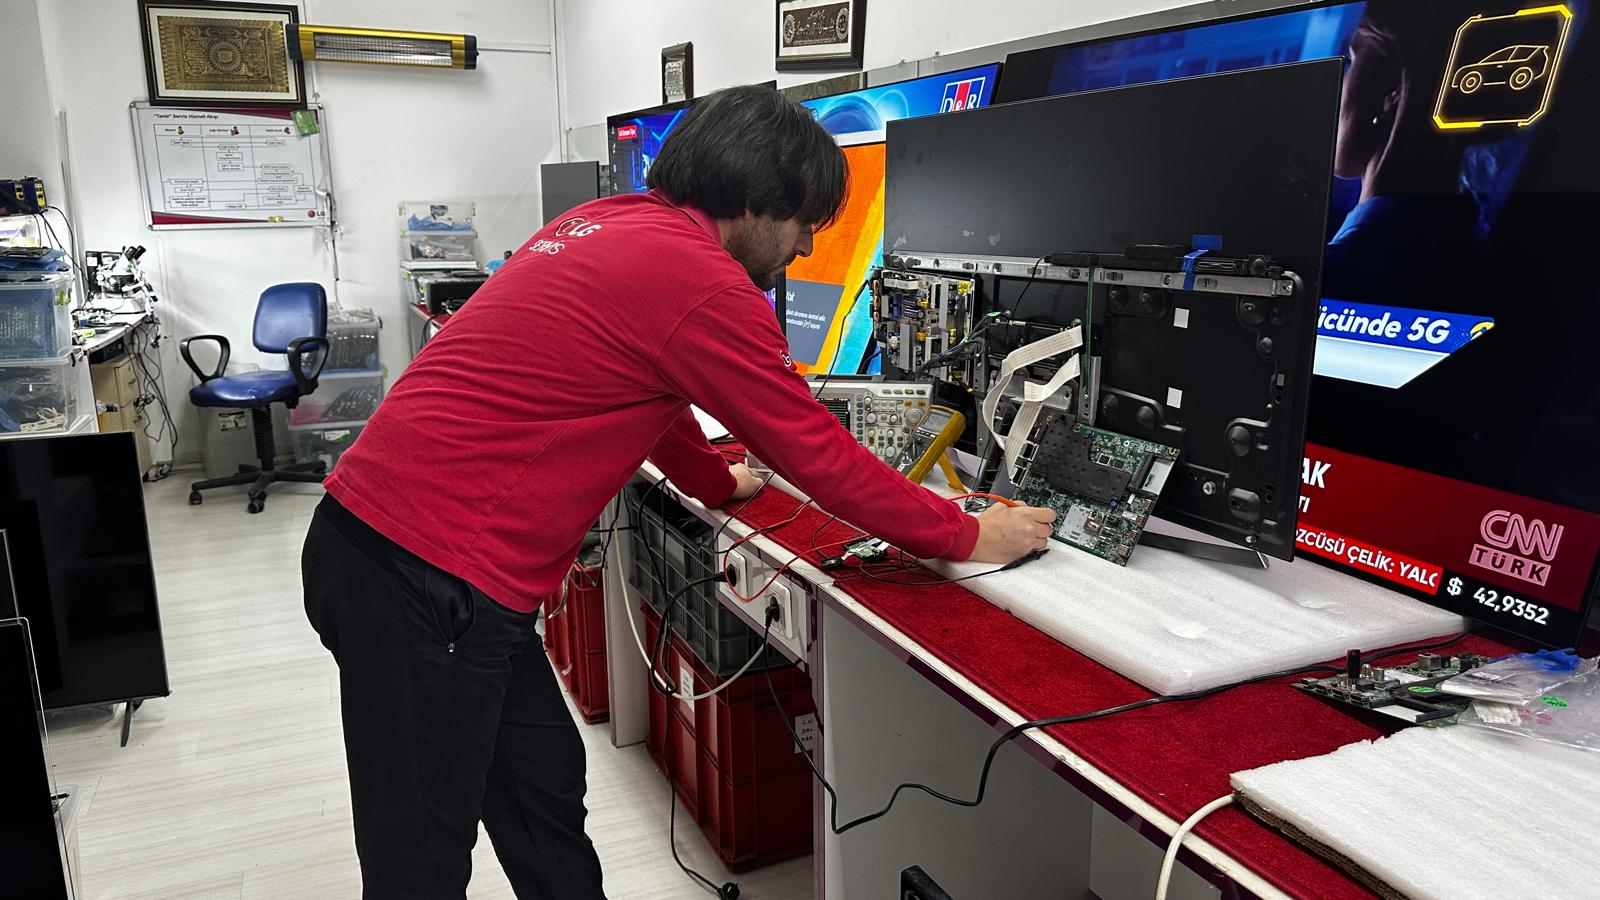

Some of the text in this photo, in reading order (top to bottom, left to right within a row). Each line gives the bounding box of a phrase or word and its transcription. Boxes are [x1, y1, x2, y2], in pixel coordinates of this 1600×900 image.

[943, 94, 977, 113] D&R
[567, 221, 602, 237] LG
[1406, 316, 1451, 344] 5G
[1296, 528, 1346, 556] ZCÜSÜ
[1347, 545, 1395, 574] ÇELİK:
[1480, 509, 1564, 562] CNN
[1472, 546, 1547, 584] TÜRK
[1446, 576, 1549, 625] $ 42,9352
